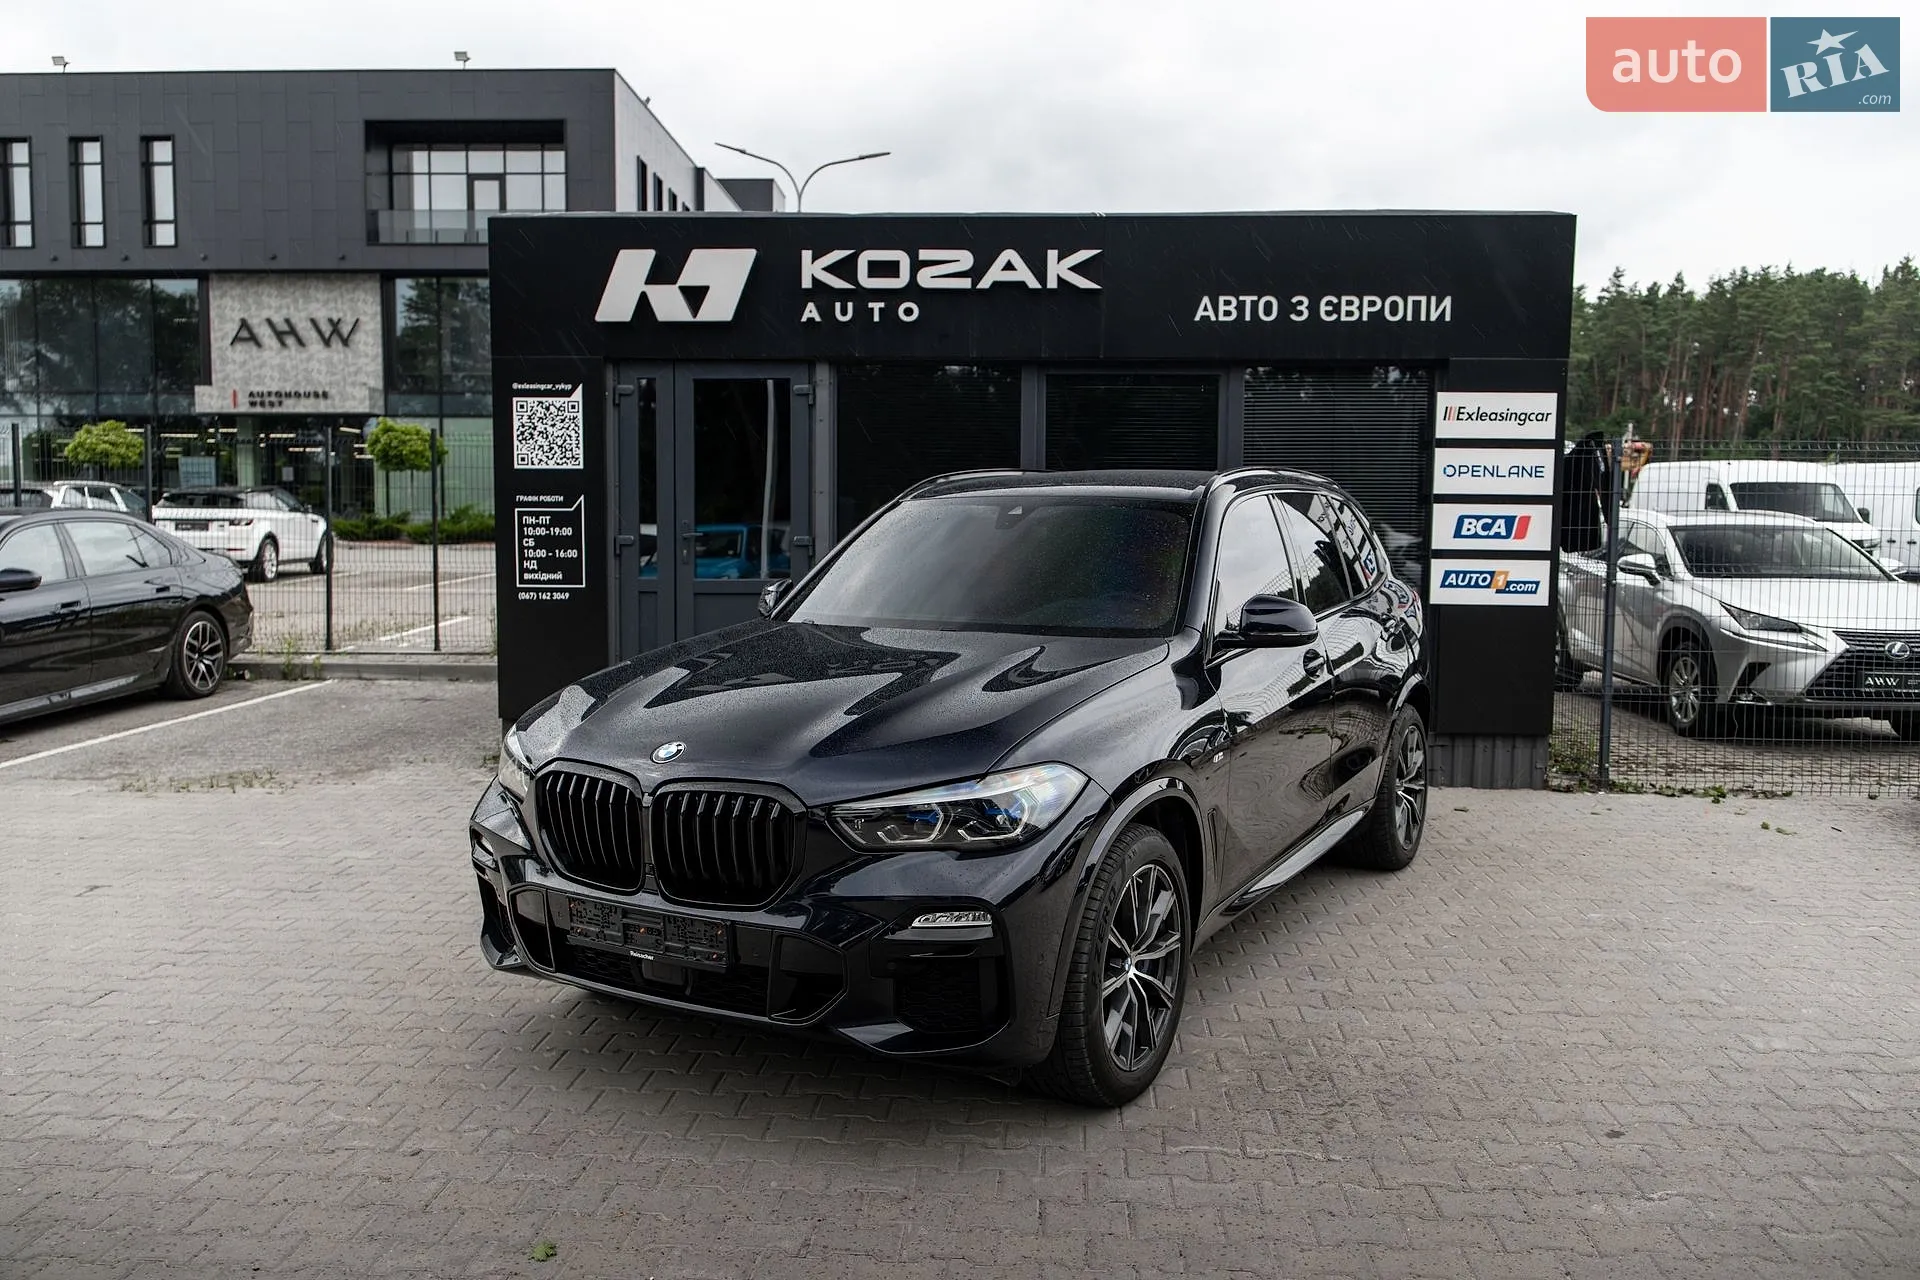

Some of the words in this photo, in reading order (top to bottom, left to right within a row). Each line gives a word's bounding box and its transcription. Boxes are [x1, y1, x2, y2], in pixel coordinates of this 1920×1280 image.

[801, 248, 1103, 290] KOZAK
[801, 301, 920, 323] AUTO
[1194, 295, 1279, 322] АВТО
[1319, 295, 1453, 322] ЄВРОПИ
[229, 317, 360, 348] AHW
[248, 390, 329, 399] AUTOHOUSE
[1457, 406, 1552, 426] Exleasingcar
[1443, 464, 1545, 478] OPENLANE
[522, 516, 551, 525] ПН-ПТ
[523, 527, 573, 536] 10:00-19:00
[1461, 518, 1507, 536] BCA
[523, 538, 535, 547] СБ
[524, 549, 547, 558] 10:00
[555, 549, 578, 558] 16:00
[523, 560, 538, 570] НД
[523, 571, 563, 581] вихідний
[518, 592, 537, 600] (067)
[538, 592, 551, 600] 162
